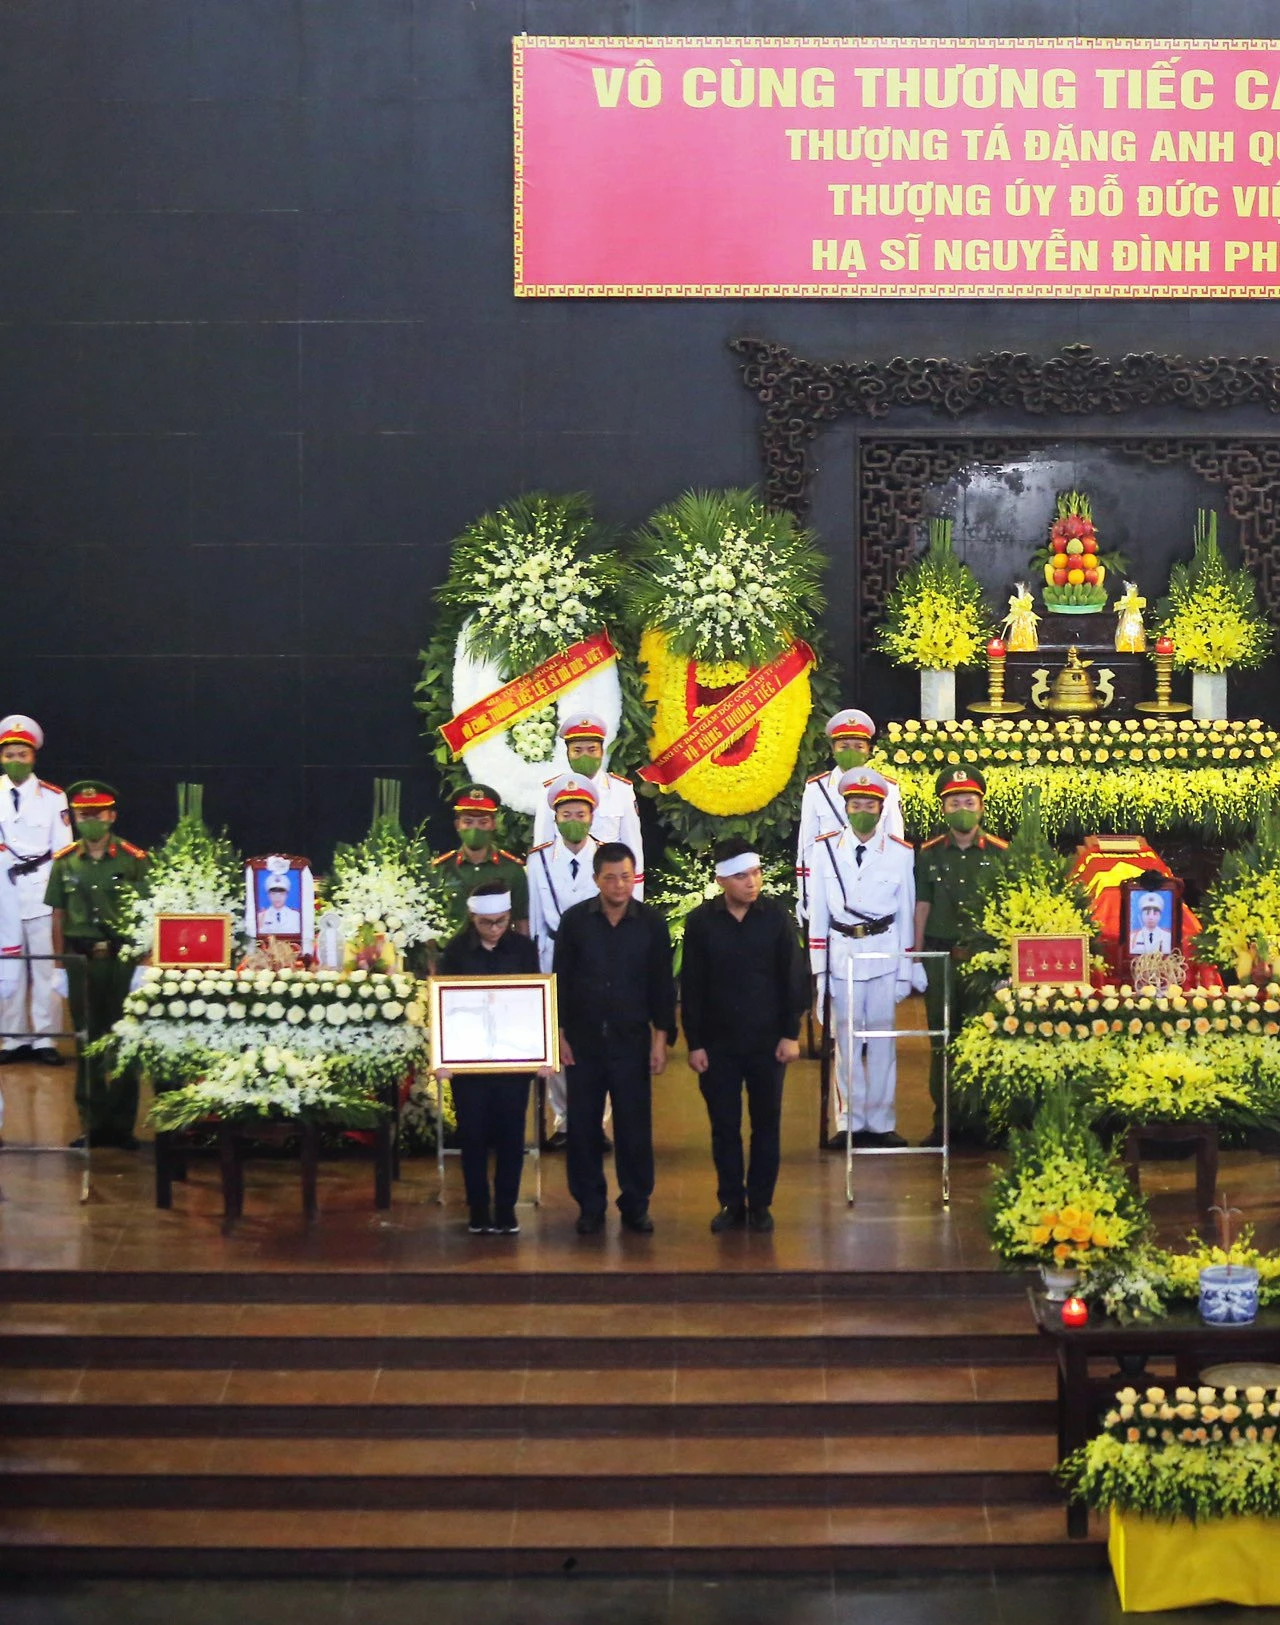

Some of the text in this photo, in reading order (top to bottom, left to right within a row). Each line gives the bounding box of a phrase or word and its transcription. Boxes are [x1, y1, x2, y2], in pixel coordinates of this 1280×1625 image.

[592, 59, 663, 108] VÔ
[682, 59, 835, 109] CÙNG
[854, 64, 1077, 109] THƯƠNG
[1096, 57, 1214, 110] TIẾC
[785, 127, 949, 167] THƯỢNG
[962, 123, 1011, 161] TÁ
[1024, 124, 1137, 168] ĐẶNG
[1150, 131, 1235, 162] ANH
[828, 181, 991, 222] THƯỢNG
[1005, 178, 1057, 216] ÚY
[1070, 174, 1124, 217] ĐỖ
[1137, 179, 1219, 217] ĐỨC
[812, 239, 867, 277] HẠ
[880, 234, 921, 271] SĨ
[935, 229, 1099, 272] NGUYỄN
[1112, 234, 1210, 272] ĐÌNH
[754, 674, 765, 686] AN
[683, 745, 699, 761] VÔ
[698, 727, 722, 750] CÙNG
[722, 700, 756, 729] THƯƠNG
[754, 682, 775, 703] TIẾC
